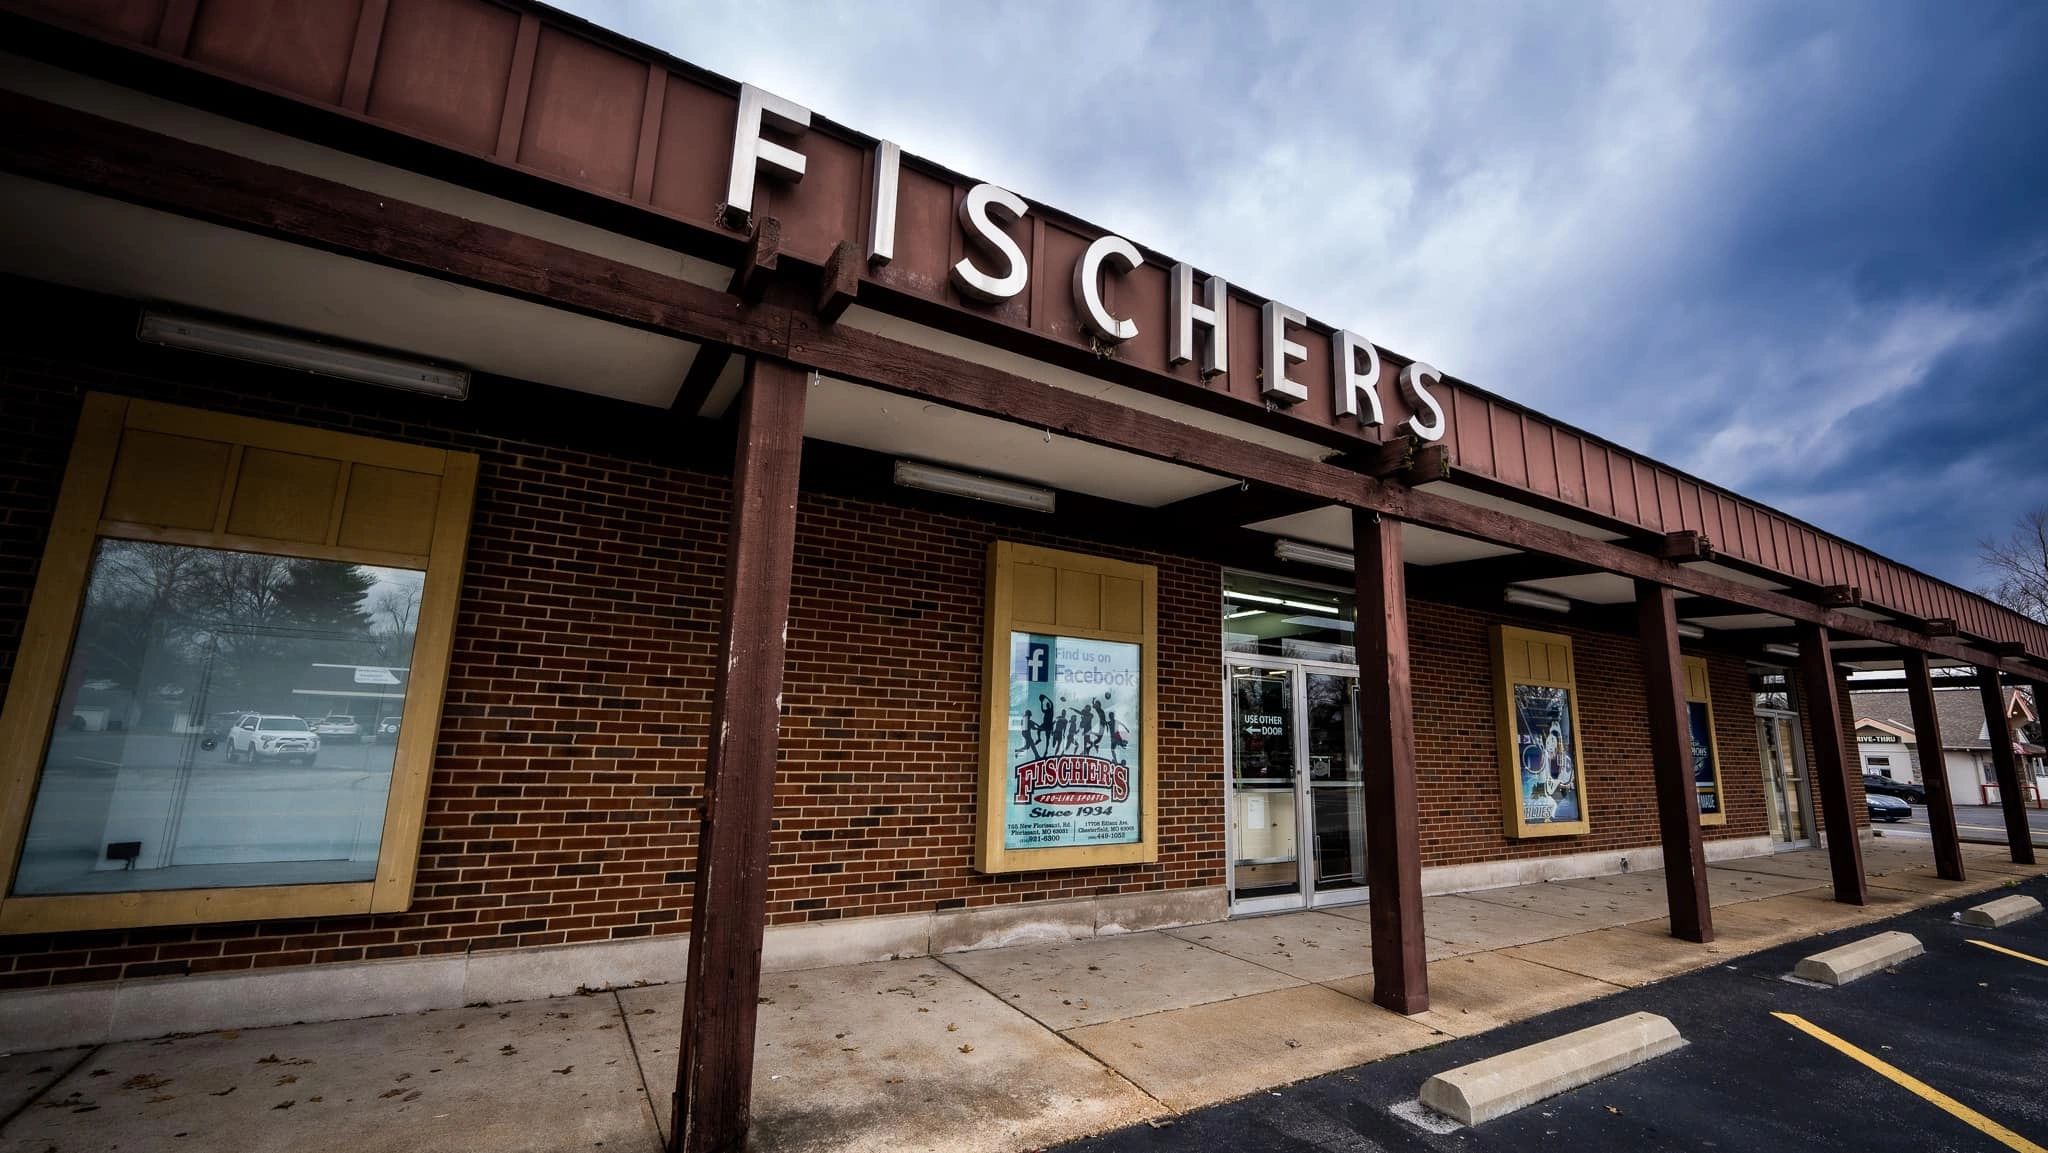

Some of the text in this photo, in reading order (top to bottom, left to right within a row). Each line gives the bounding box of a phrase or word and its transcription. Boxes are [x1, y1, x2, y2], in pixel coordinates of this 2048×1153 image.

[726, 82, 1446, 441] FISCHERS
[1055, 648, 1111, 663] Find us on
[1055, 664, 1137, 686] Facebook
[1244, 714, 1283, 725] USE OTHER
[1262, 726, 1283, 736] DOOR
[1015, 755, 1129, 804] FISCHER'S
[1029, 806, 1113, 818] Since 1934
